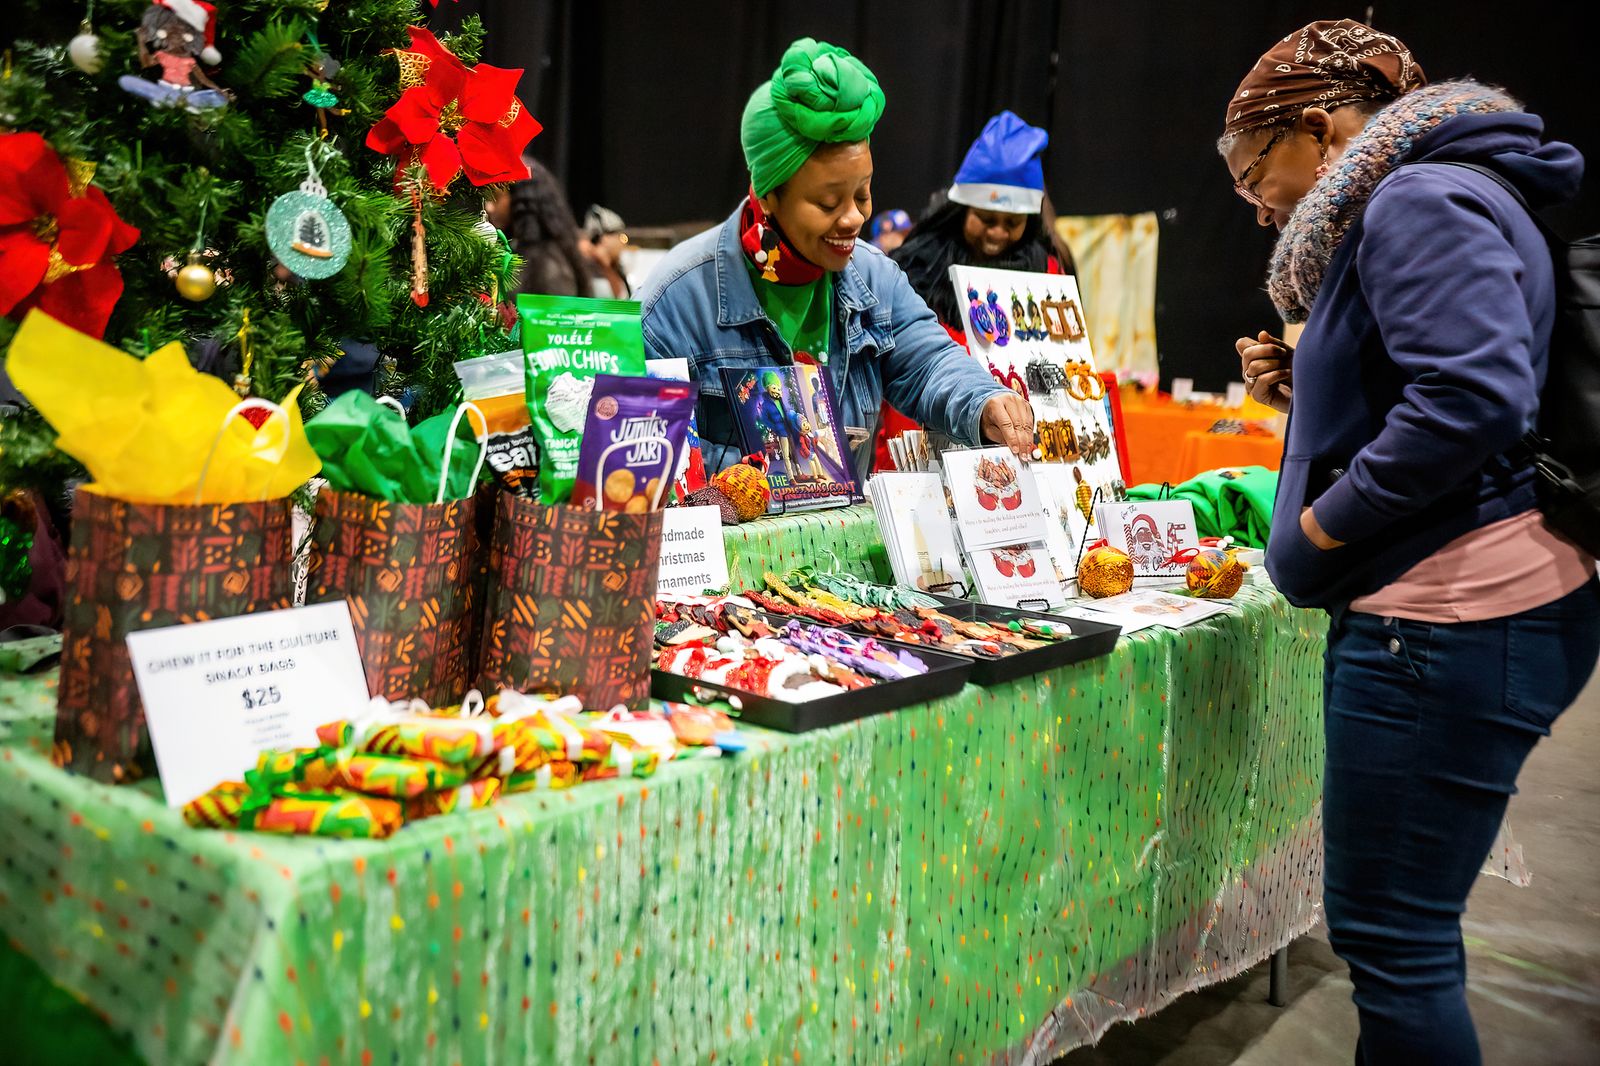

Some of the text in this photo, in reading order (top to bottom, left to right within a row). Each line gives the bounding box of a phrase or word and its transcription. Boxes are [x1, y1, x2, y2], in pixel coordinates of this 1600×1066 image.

[547, 329, 593, 346] YOLÉLÉ
[572, 349, 620, 374] CHIPS
[625, 441, 657, 463] JAR
[767, 474, 790, 488] THE
[662, 527, 705, 542] ndmade
[660, 551, 706, 567] ristmas
[657, 572, 712, 589] rnaments
[249, 640, 275, 654] THE
[280, 628, 341, 650] CULTURE
[242, 685, 282, 710] $25
